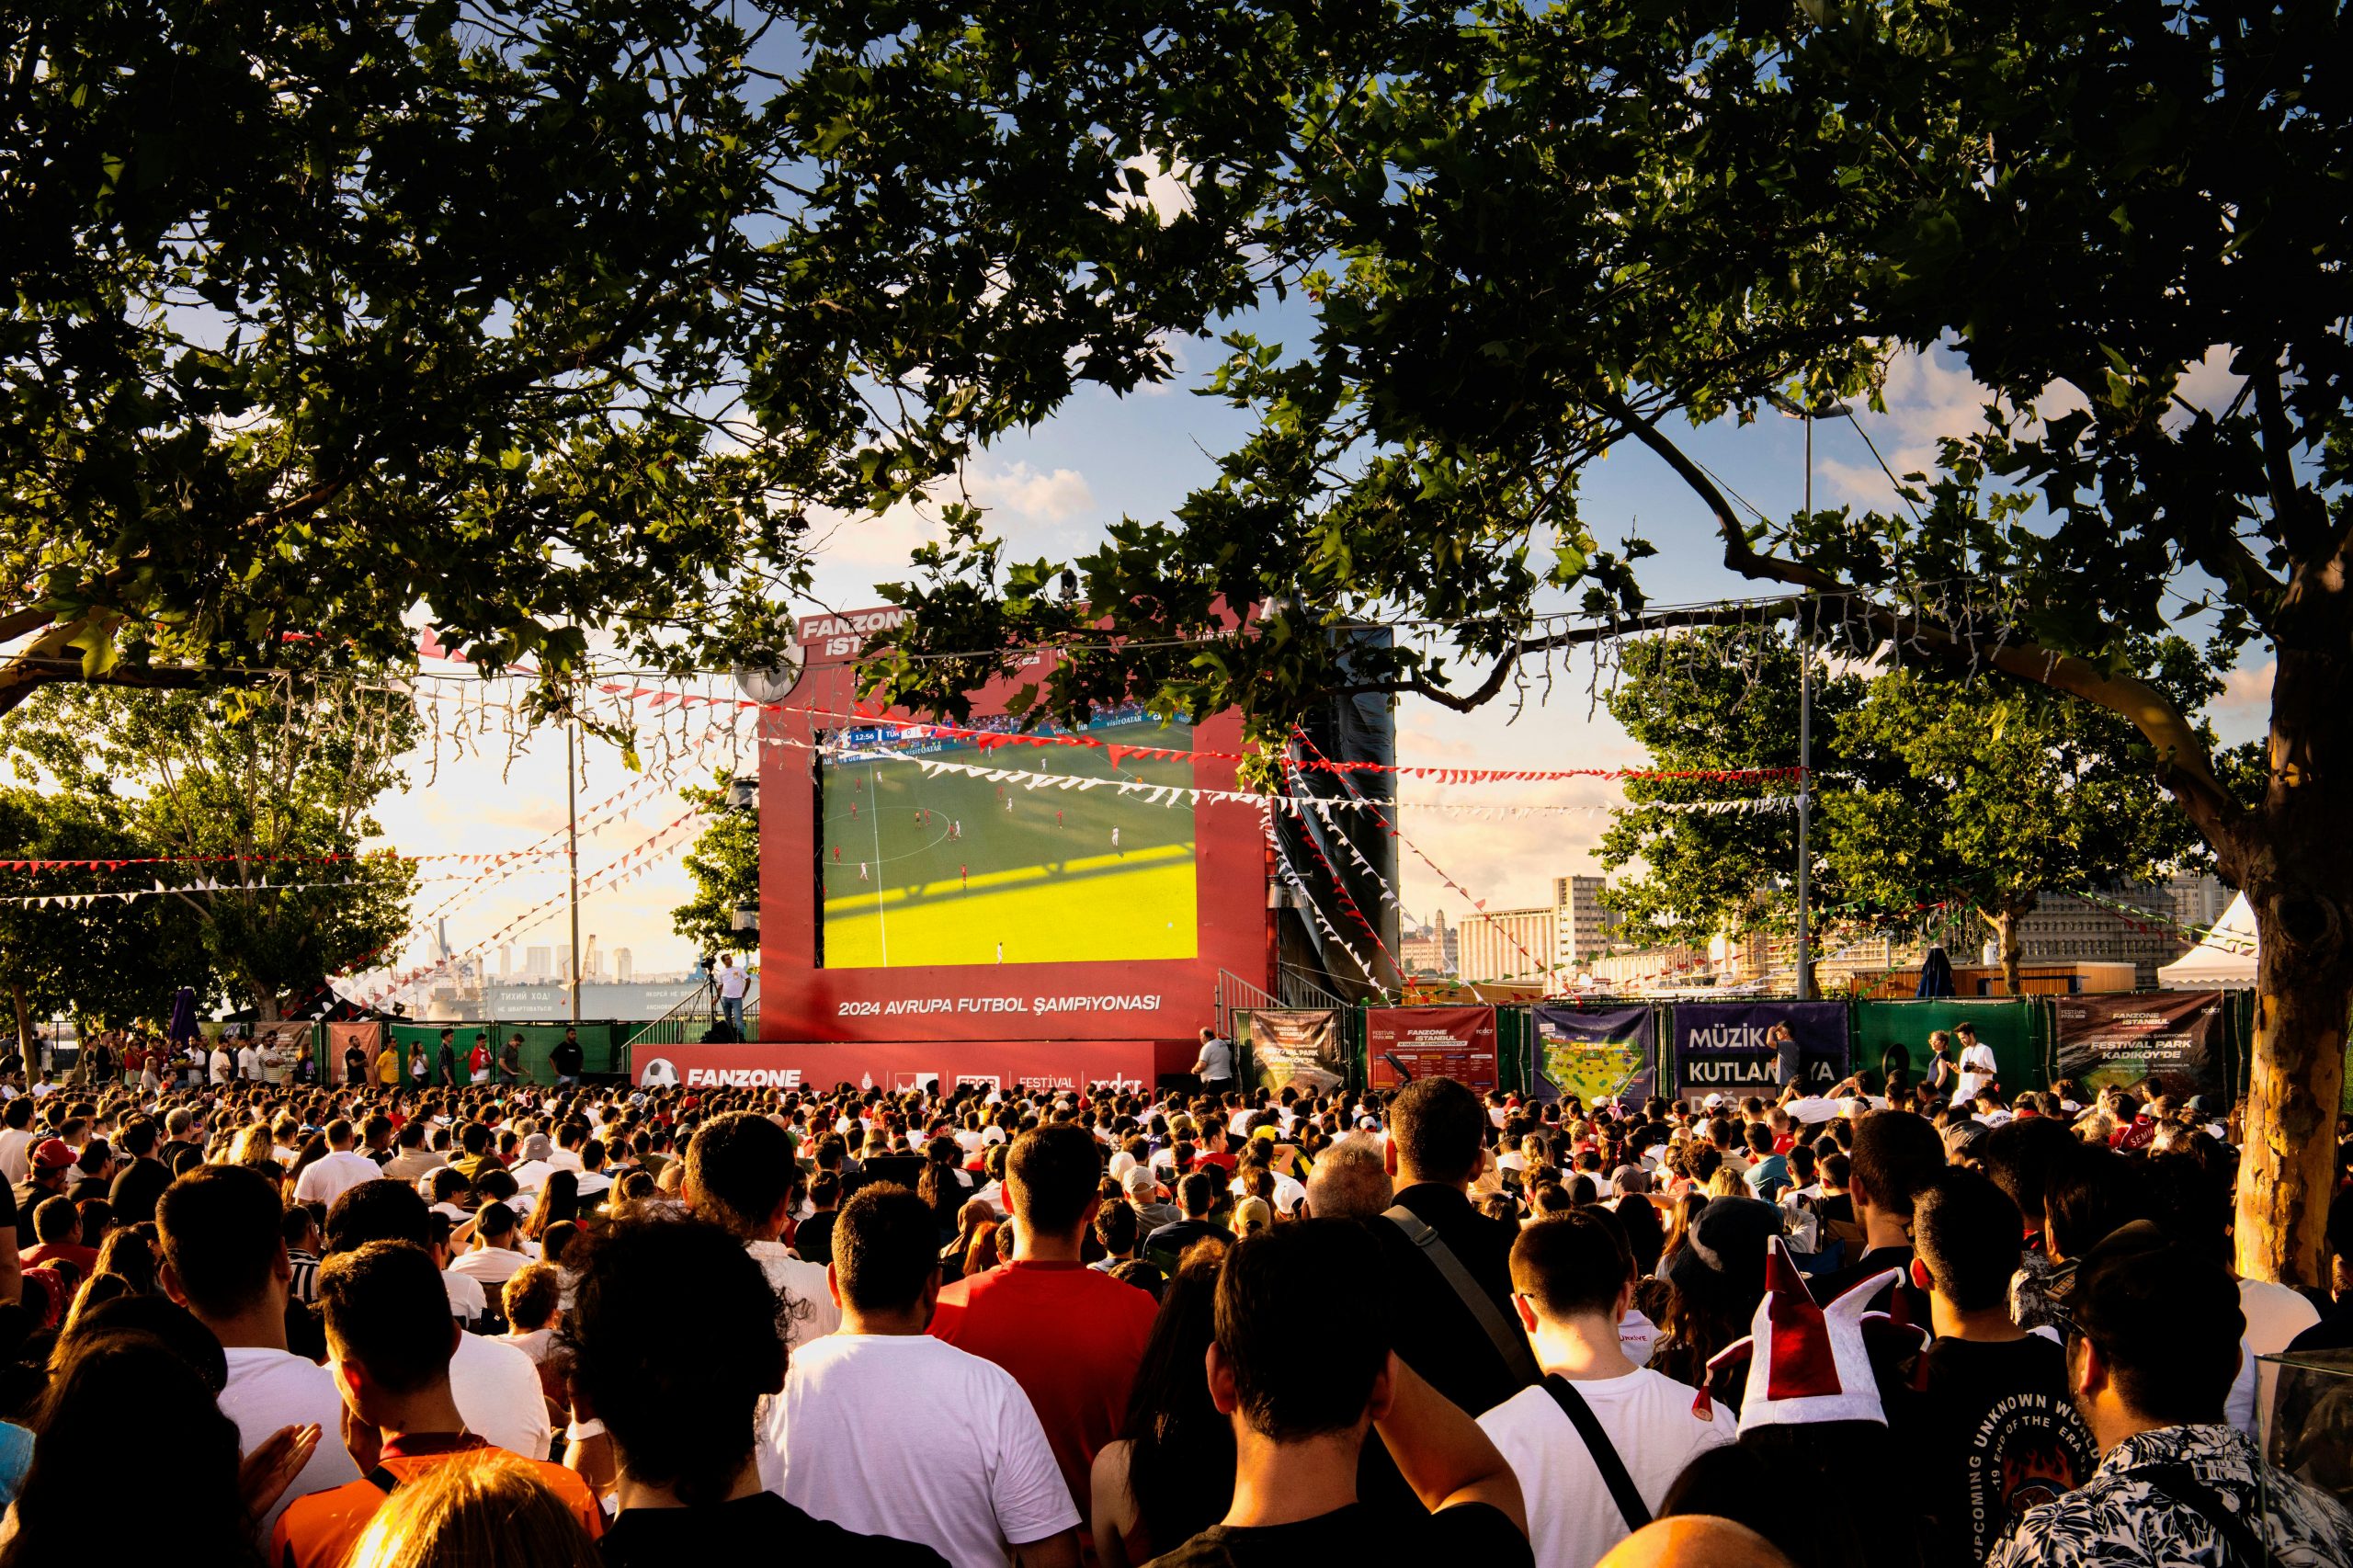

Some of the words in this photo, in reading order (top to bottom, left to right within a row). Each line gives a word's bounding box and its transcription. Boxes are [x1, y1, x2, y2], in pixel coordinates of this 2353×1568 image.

[855, 733, 875, 741] 12:56
[500, 991, 528, 1001] ТИХИЙ
[838, 1001, 881, 1016] 2024
[884, 998, 952, 1015] AVRUPA
[958, 997, 1028, 1013] FUTBOL
[2155, 1040, 2192, 1049] PARK
[688, 1069, 801, 1087] FANZONE
[1973, 1392, 2048, 1449] UNKNOWN
[1994, 1435, 2006, 1462] END
[2006, 1419, 2018, 1435] OF
[2022, 1415, 2050, 1427] THE
[2058, 1426, 2082, 1453] ERA
[1969, 1456, 1985, 1561] UPCOMING
